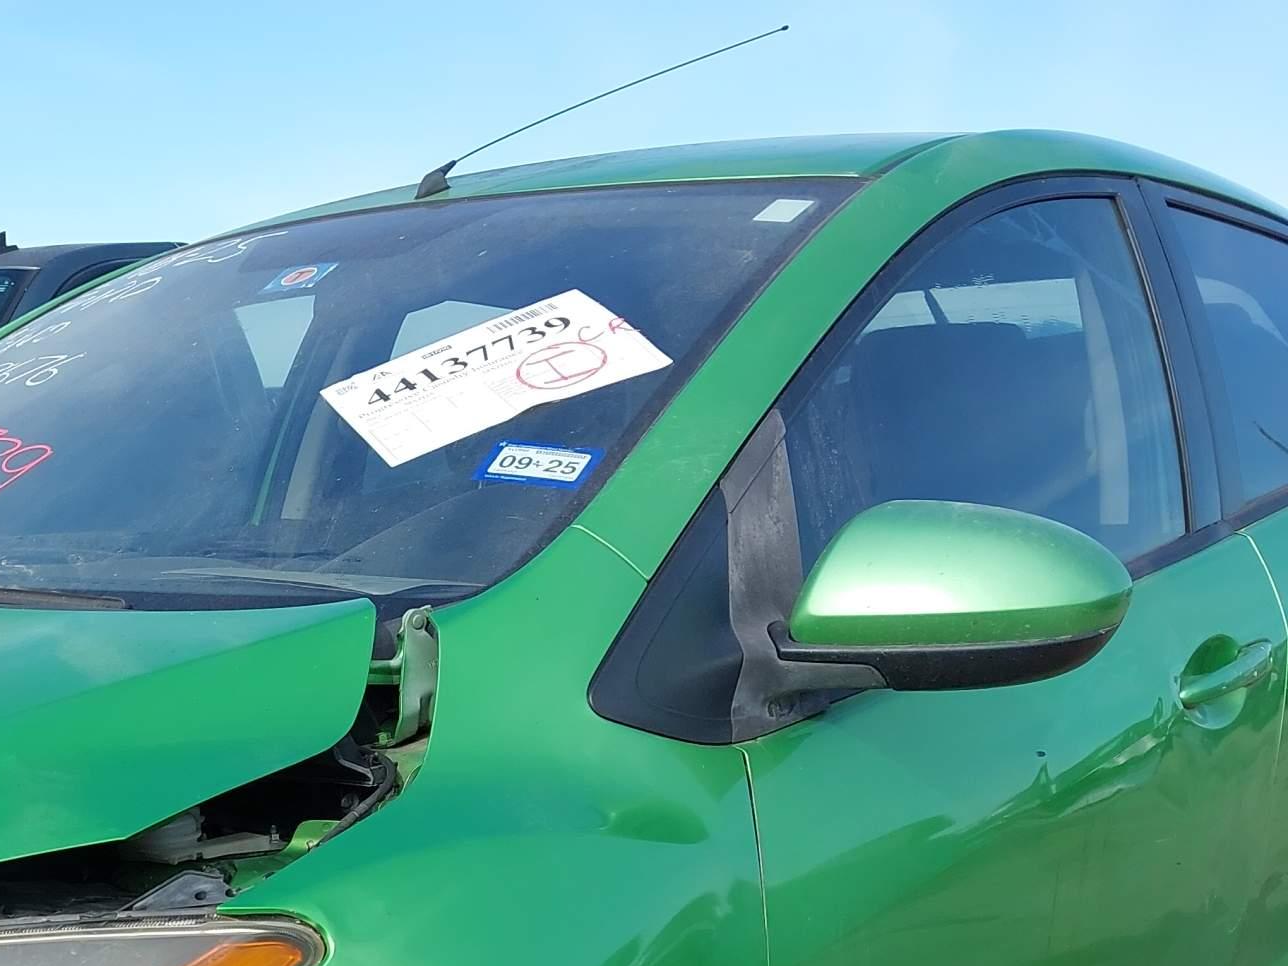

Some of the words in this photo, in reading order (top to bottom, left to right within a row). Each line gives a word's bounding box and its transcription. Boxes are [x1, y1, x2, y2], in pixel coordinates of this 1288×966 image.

[368, 317, 571, 405] 44137739
[499, 455, 533, 470] 09
[542, 460, 580, 475] 25
